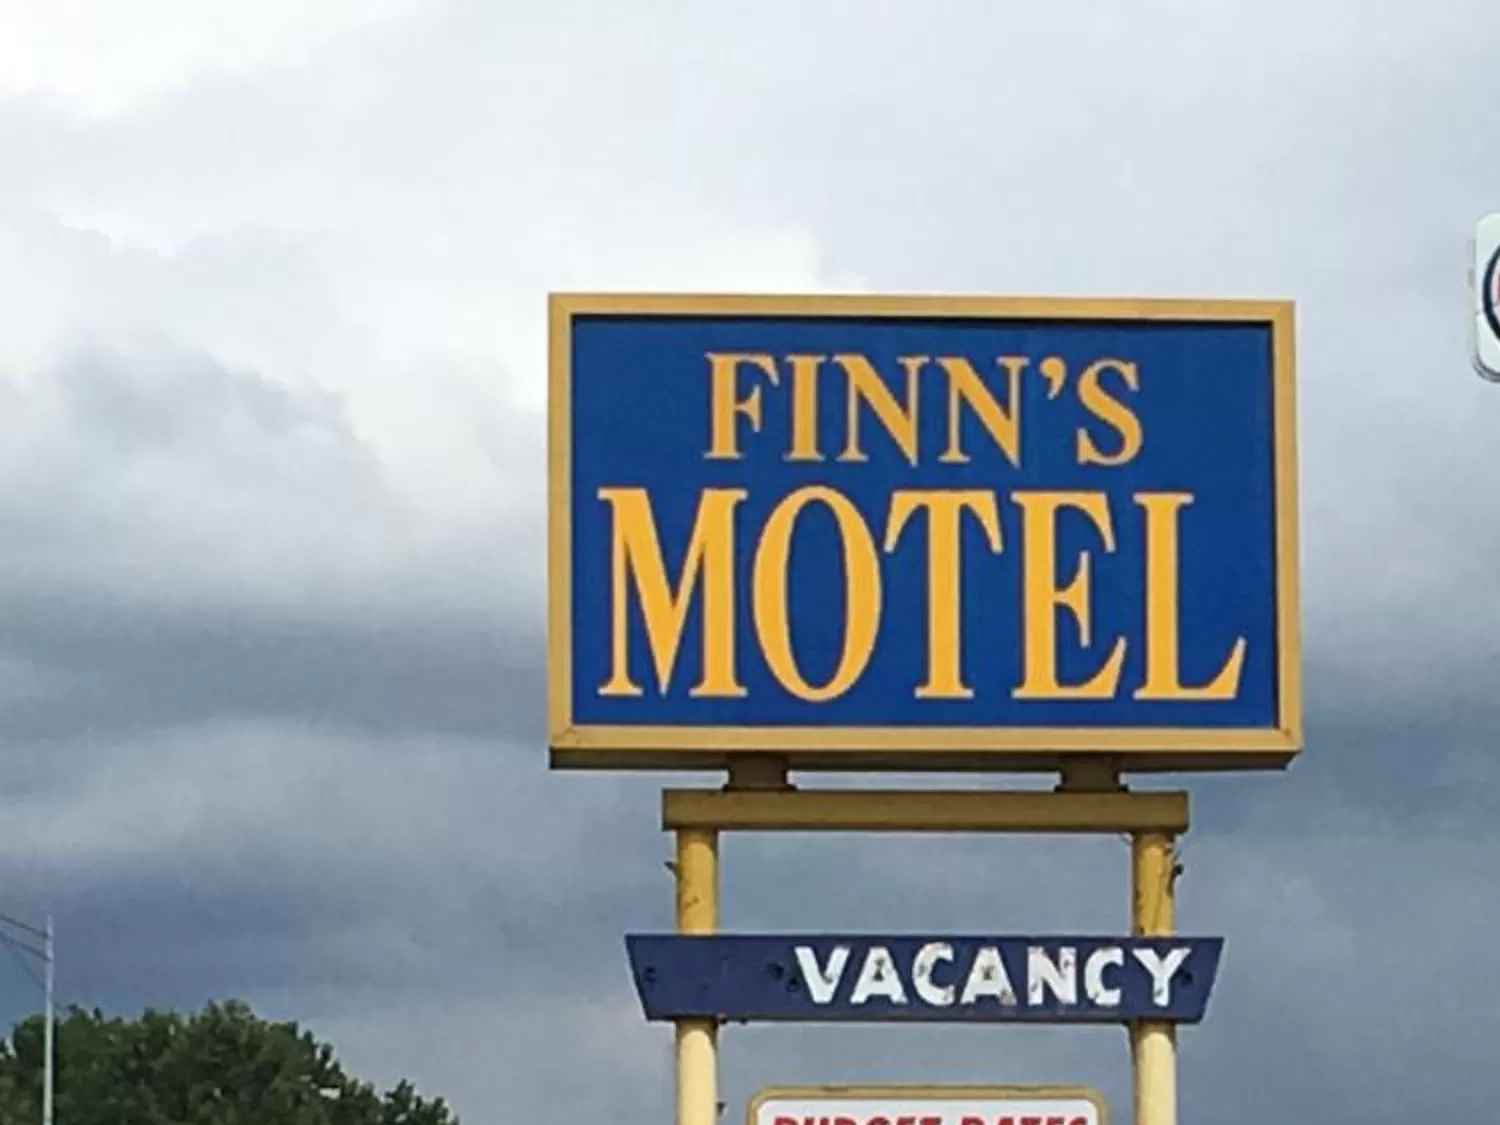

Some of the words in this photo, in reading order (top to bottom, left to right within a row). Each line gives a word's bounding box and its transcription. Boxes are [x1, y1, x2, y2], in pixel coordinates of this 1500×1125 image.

[704, 351, 1144, 469] FINN'S
[597, 484, 1247, 702] MOTEL
[794, 941, 1193, 1008] VACANCY
